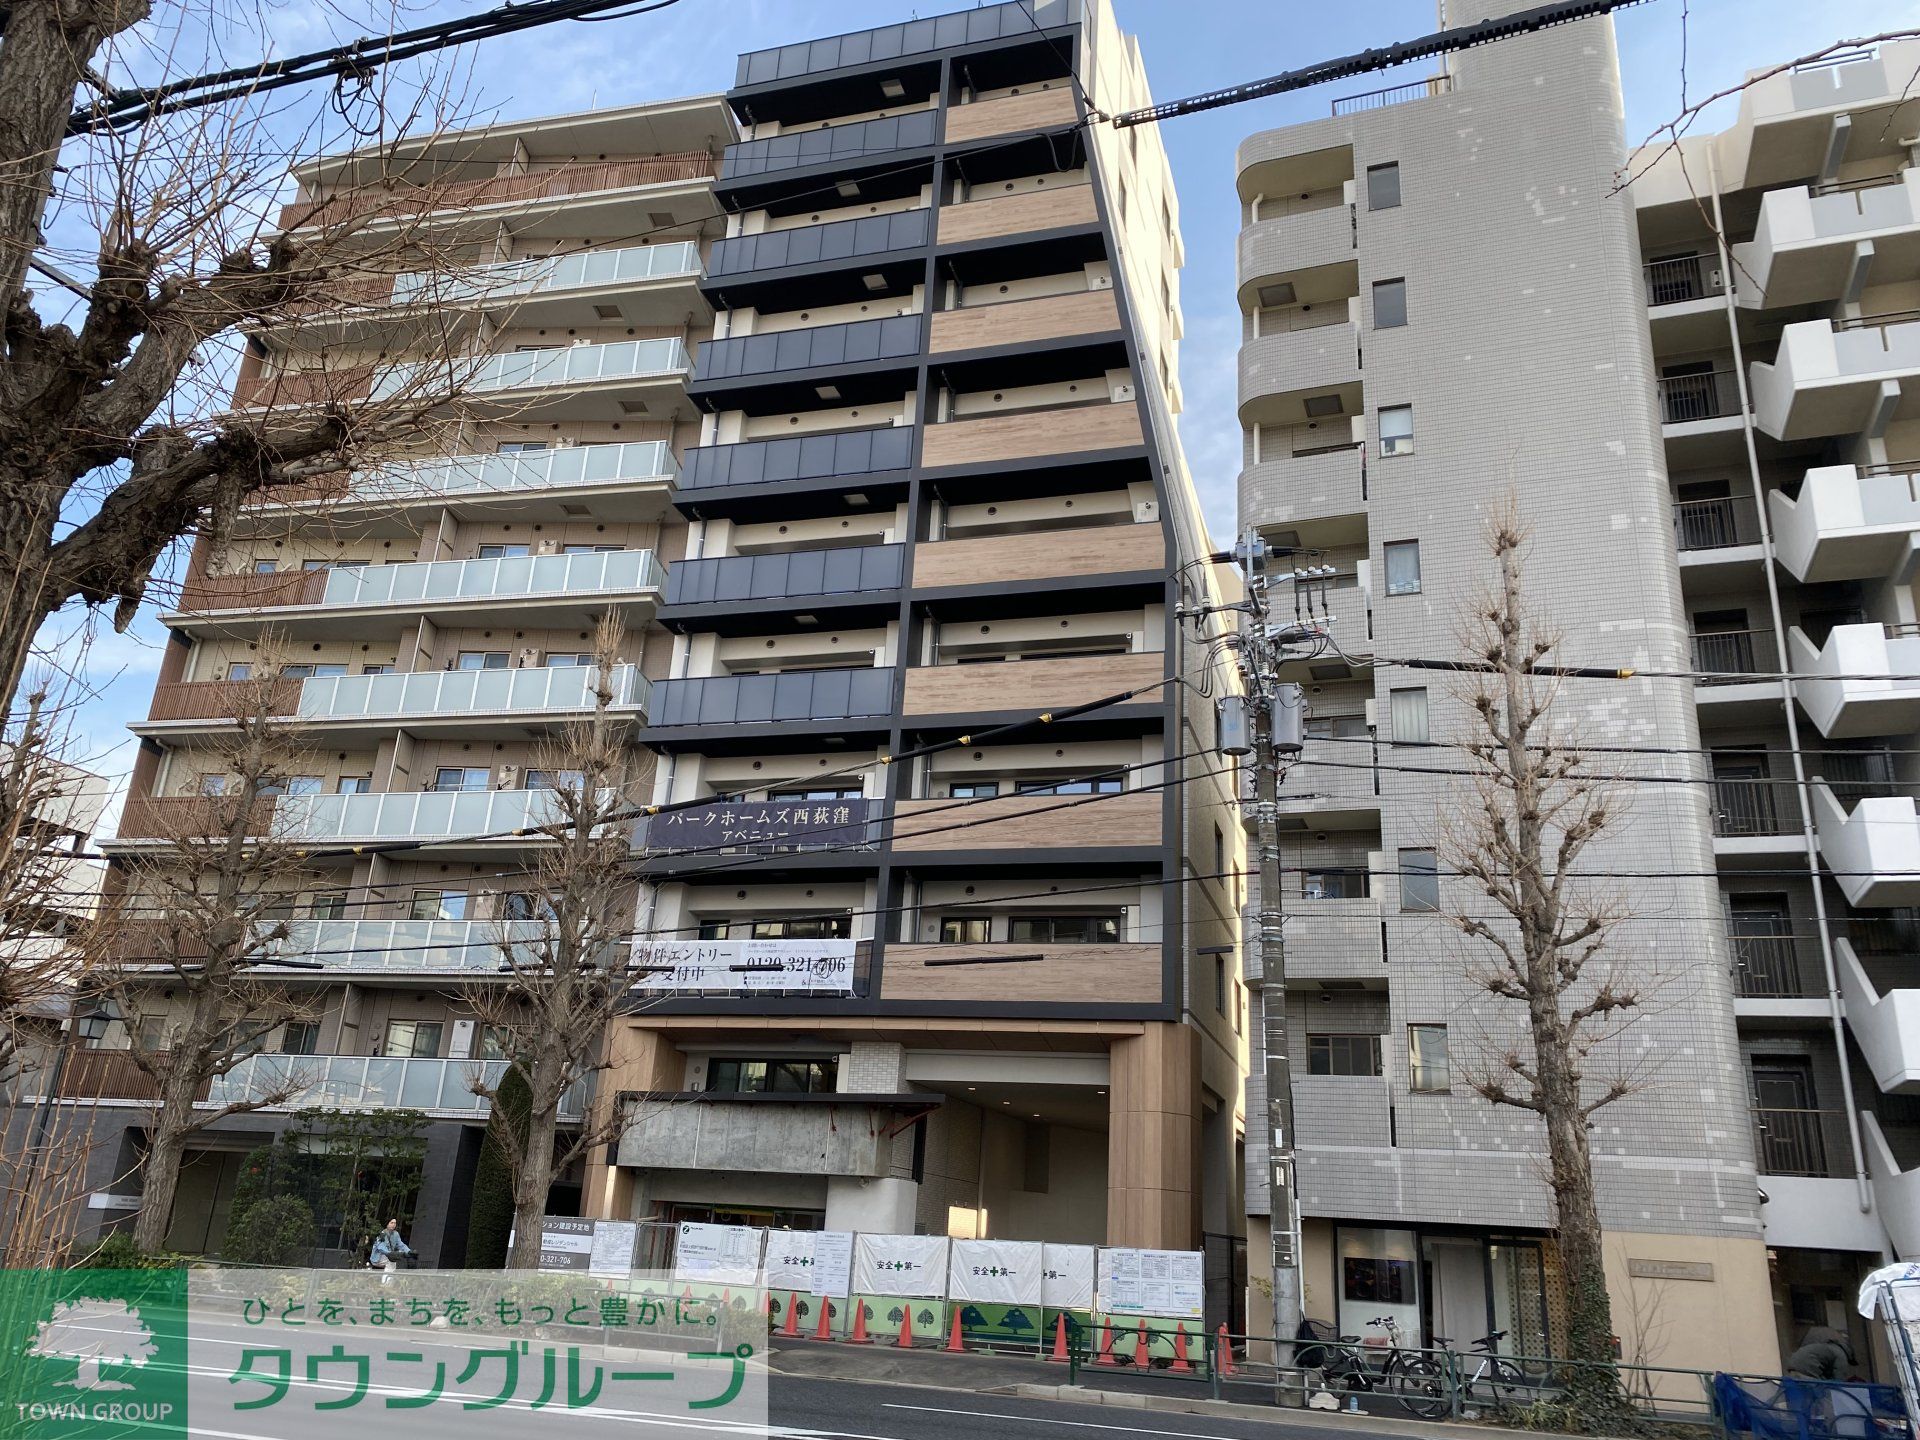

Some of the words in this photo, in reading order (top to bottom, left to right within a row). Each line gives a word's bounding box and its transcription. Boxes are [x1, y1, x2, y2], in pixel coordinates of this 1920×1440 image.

[667, 806, 851, 827] パークホームズ西荻窪
[722, 829, 789, 843] アベニュー
[747, 956, 846, 973] 0120321706
